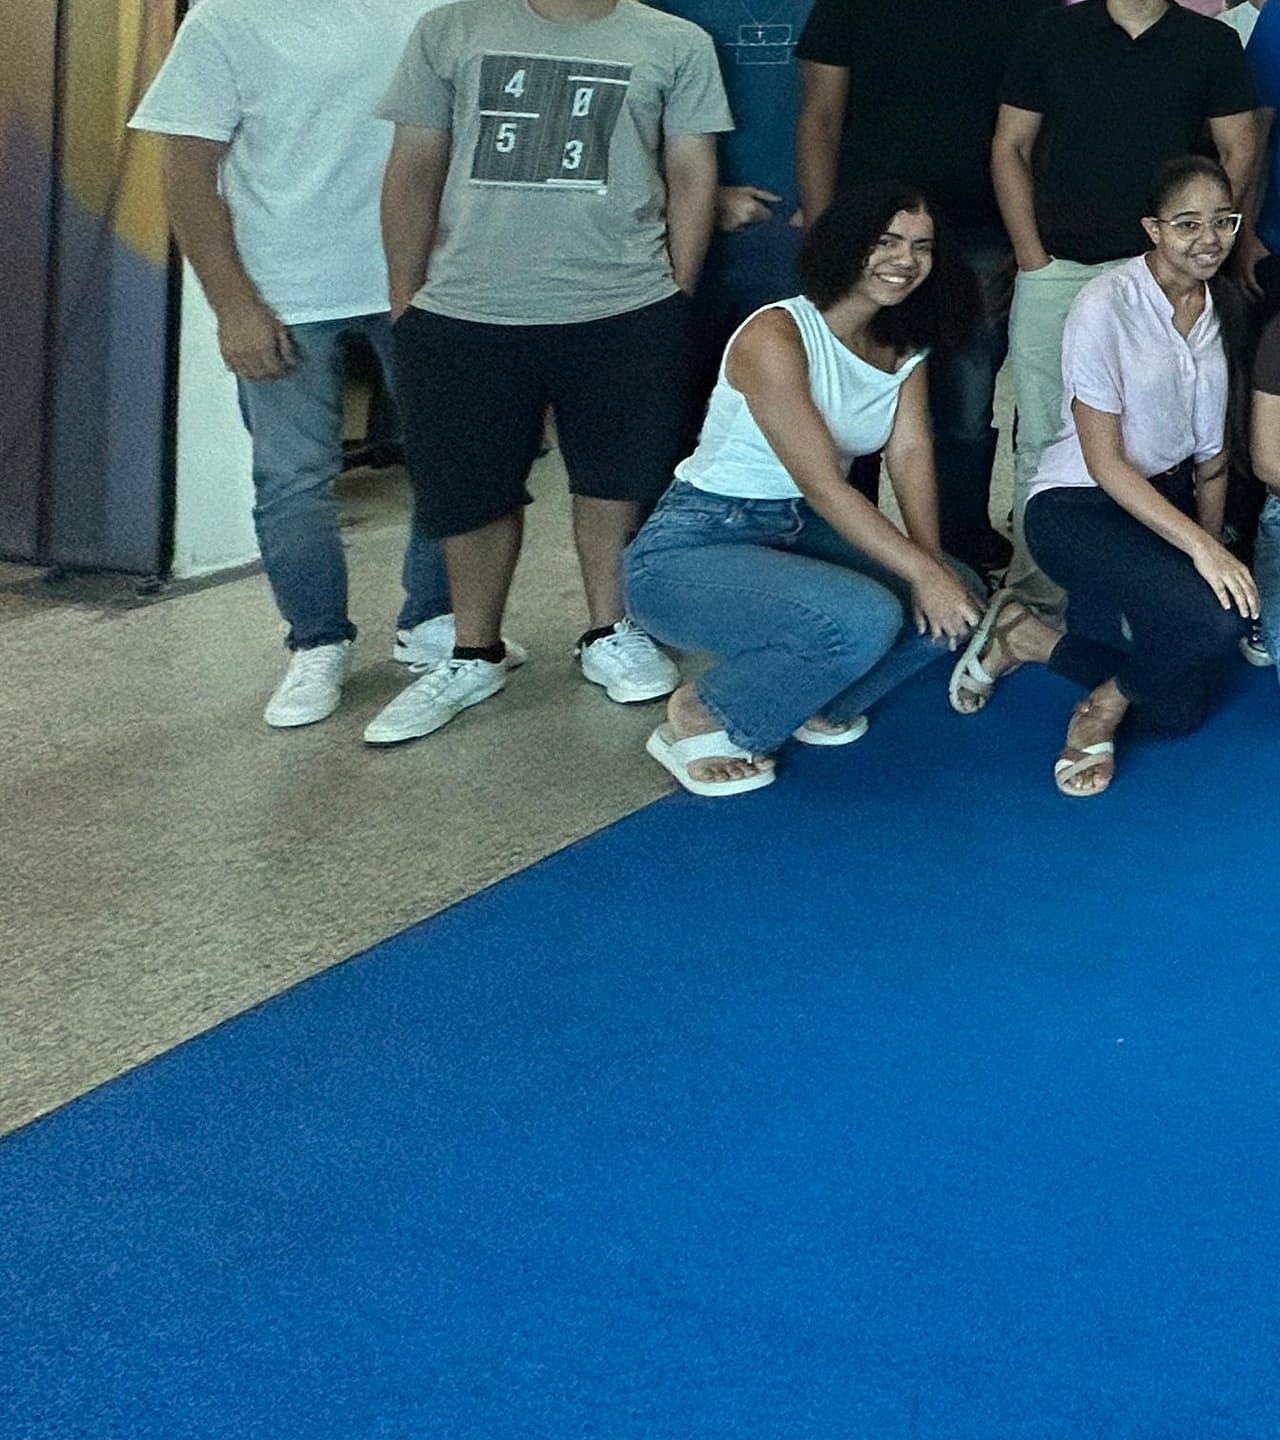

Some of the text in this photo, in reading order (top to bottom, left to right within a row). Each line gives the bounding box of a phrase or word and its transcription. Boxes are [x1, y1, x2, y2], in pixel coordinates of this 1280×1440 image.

[504, 69, 526, 98] 4
[495, 122, 584, 170] 5 3
